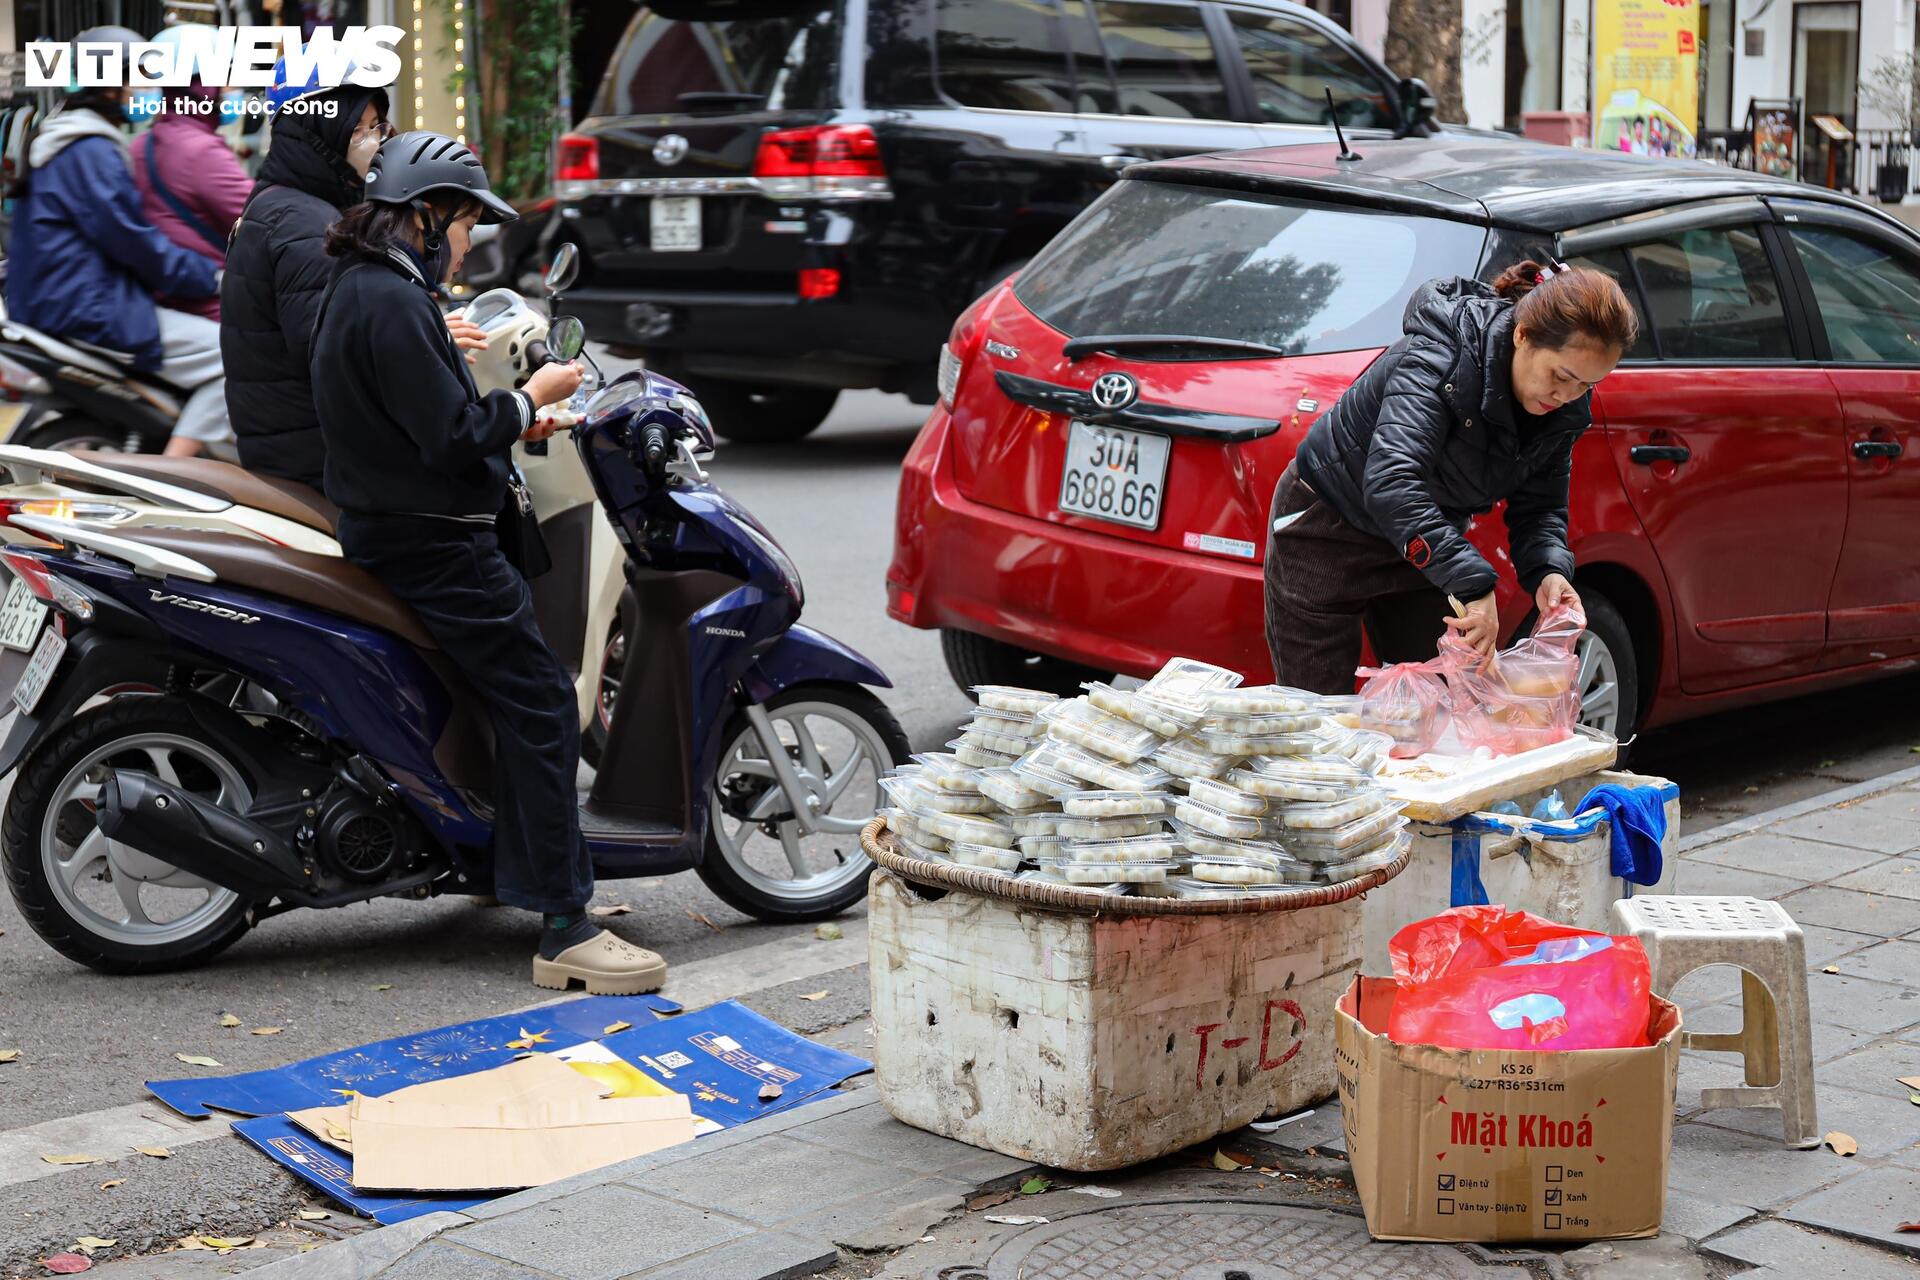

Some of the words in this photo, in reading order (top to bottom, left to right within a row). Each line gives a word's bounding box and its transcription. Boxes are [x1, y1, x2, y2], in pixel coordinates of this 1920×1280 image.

[1089, 428, 1140, 475] 30A
[1065, 468, 1157, 521] 688.66
[148, 588, 261, 624] VISION
[0, 611, 37, 646] 48.41
[705, 626, 746, 638] HONDA
[1501, 1064, 1516, 1075] KS
[1519, 1064, 1534, 1075] 26
[1450, 1111, 1508, 1154] Mặt
[1518, 1113, 1593, 1148] Khoá
[1567, 1169, 1584, 1178] Đen
[1459, 1179, 1478, 1189] Điện
[1566, 1193, 1587, 1202] Xanh
[1476, 1203, 1489, 1213] tay
[1495, 1203, 1514, 1214] Điện
[1566, 1217, 1589, 1227] Trắng
